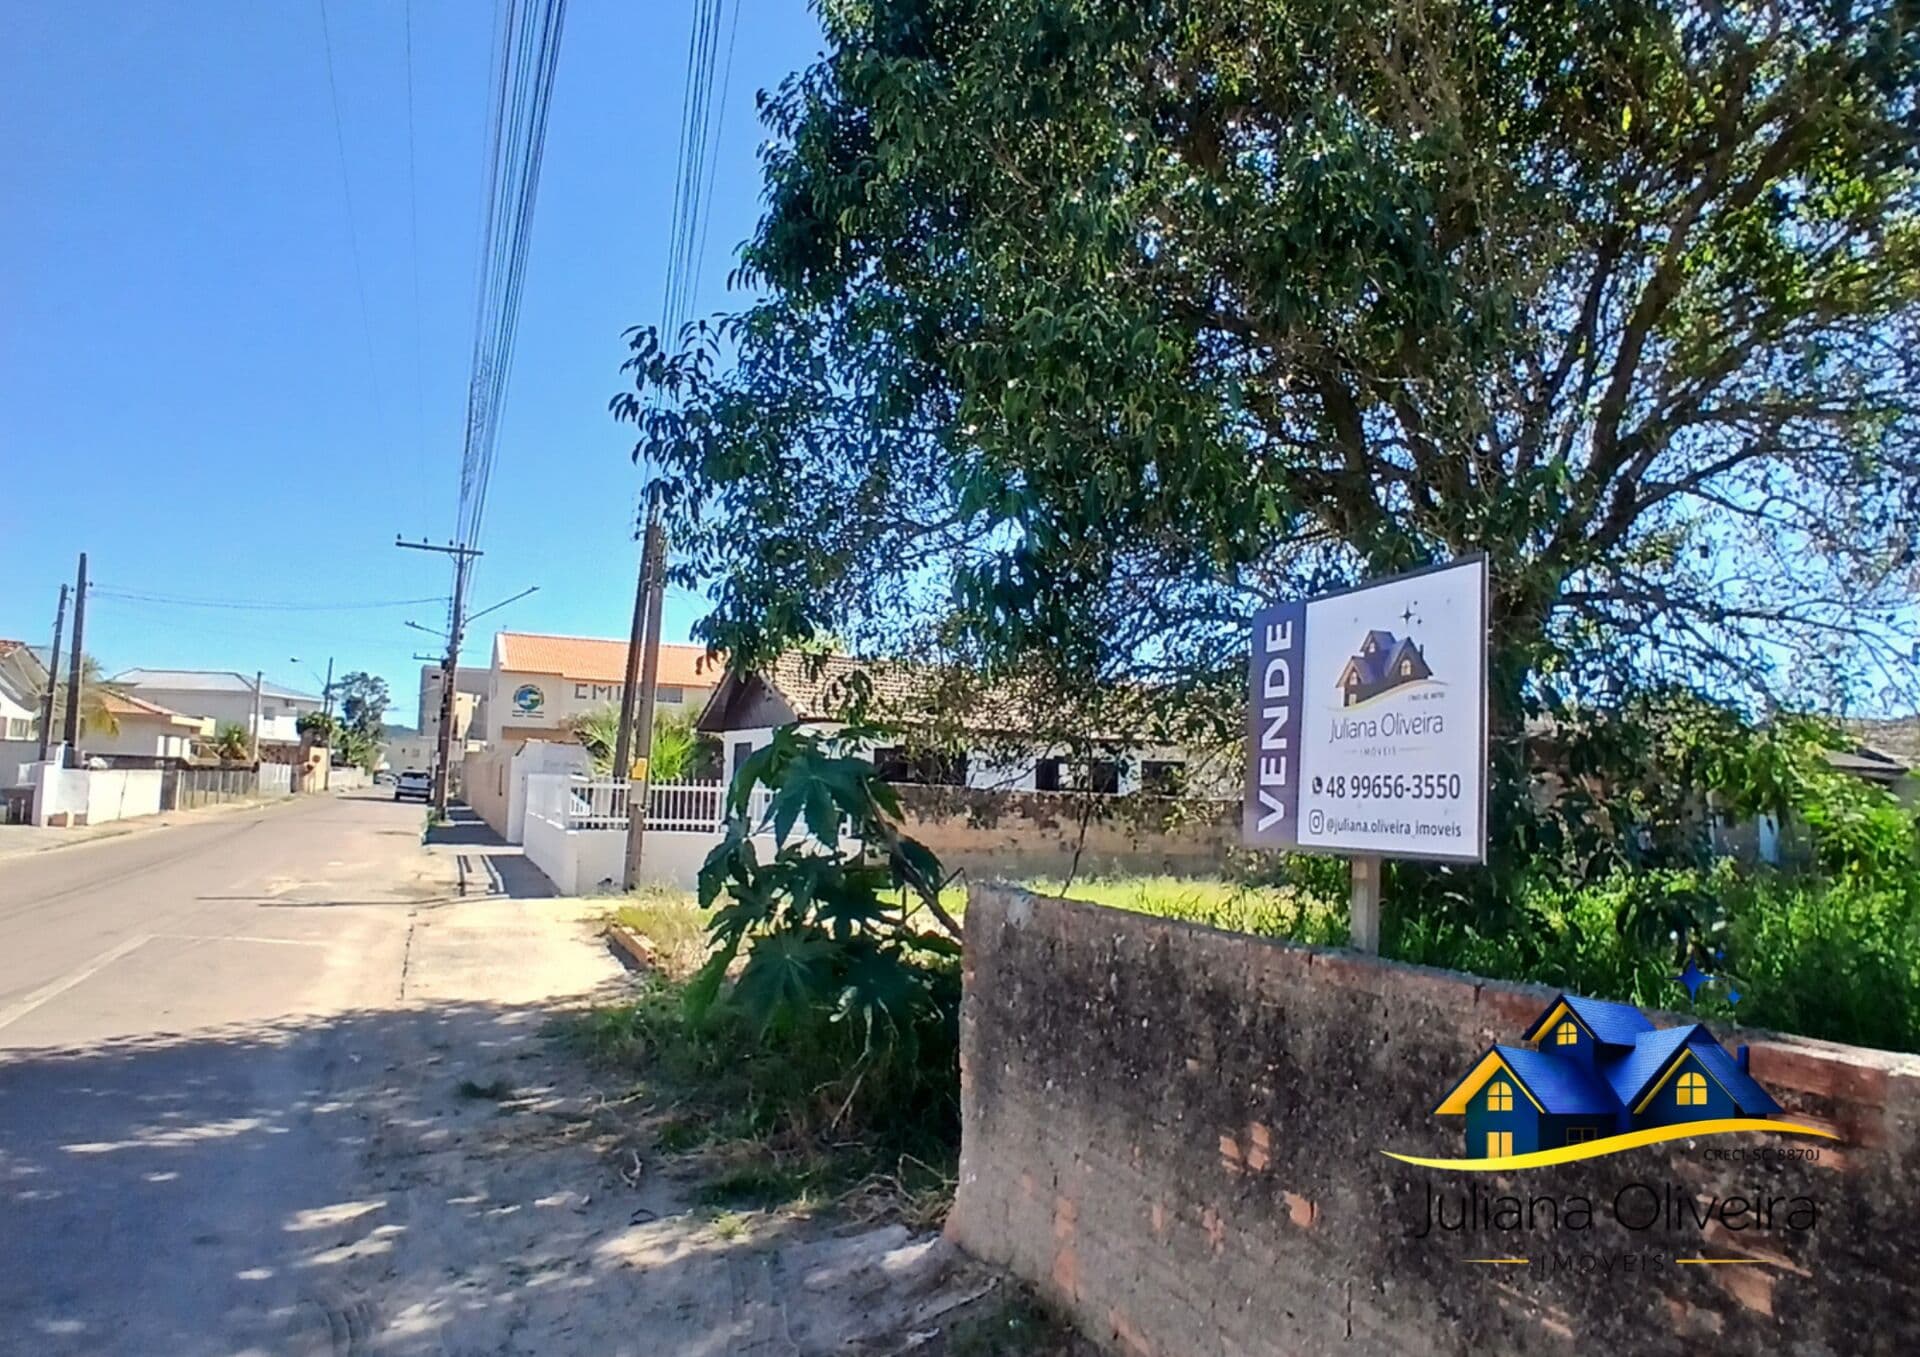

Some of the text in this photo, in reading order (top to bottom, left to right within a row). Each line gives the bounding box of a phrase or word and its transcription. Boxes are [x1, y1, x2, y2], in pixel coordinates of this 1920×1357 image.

[1257, 620, 1293, 832] VENDE
[1328, 711, 1444, 743] Juliana Oliveira
[1326, 774, 1461, 799] 48 99656-3550
[1326, 817, 1462, 837] @juliana.oliveira_imoveis
